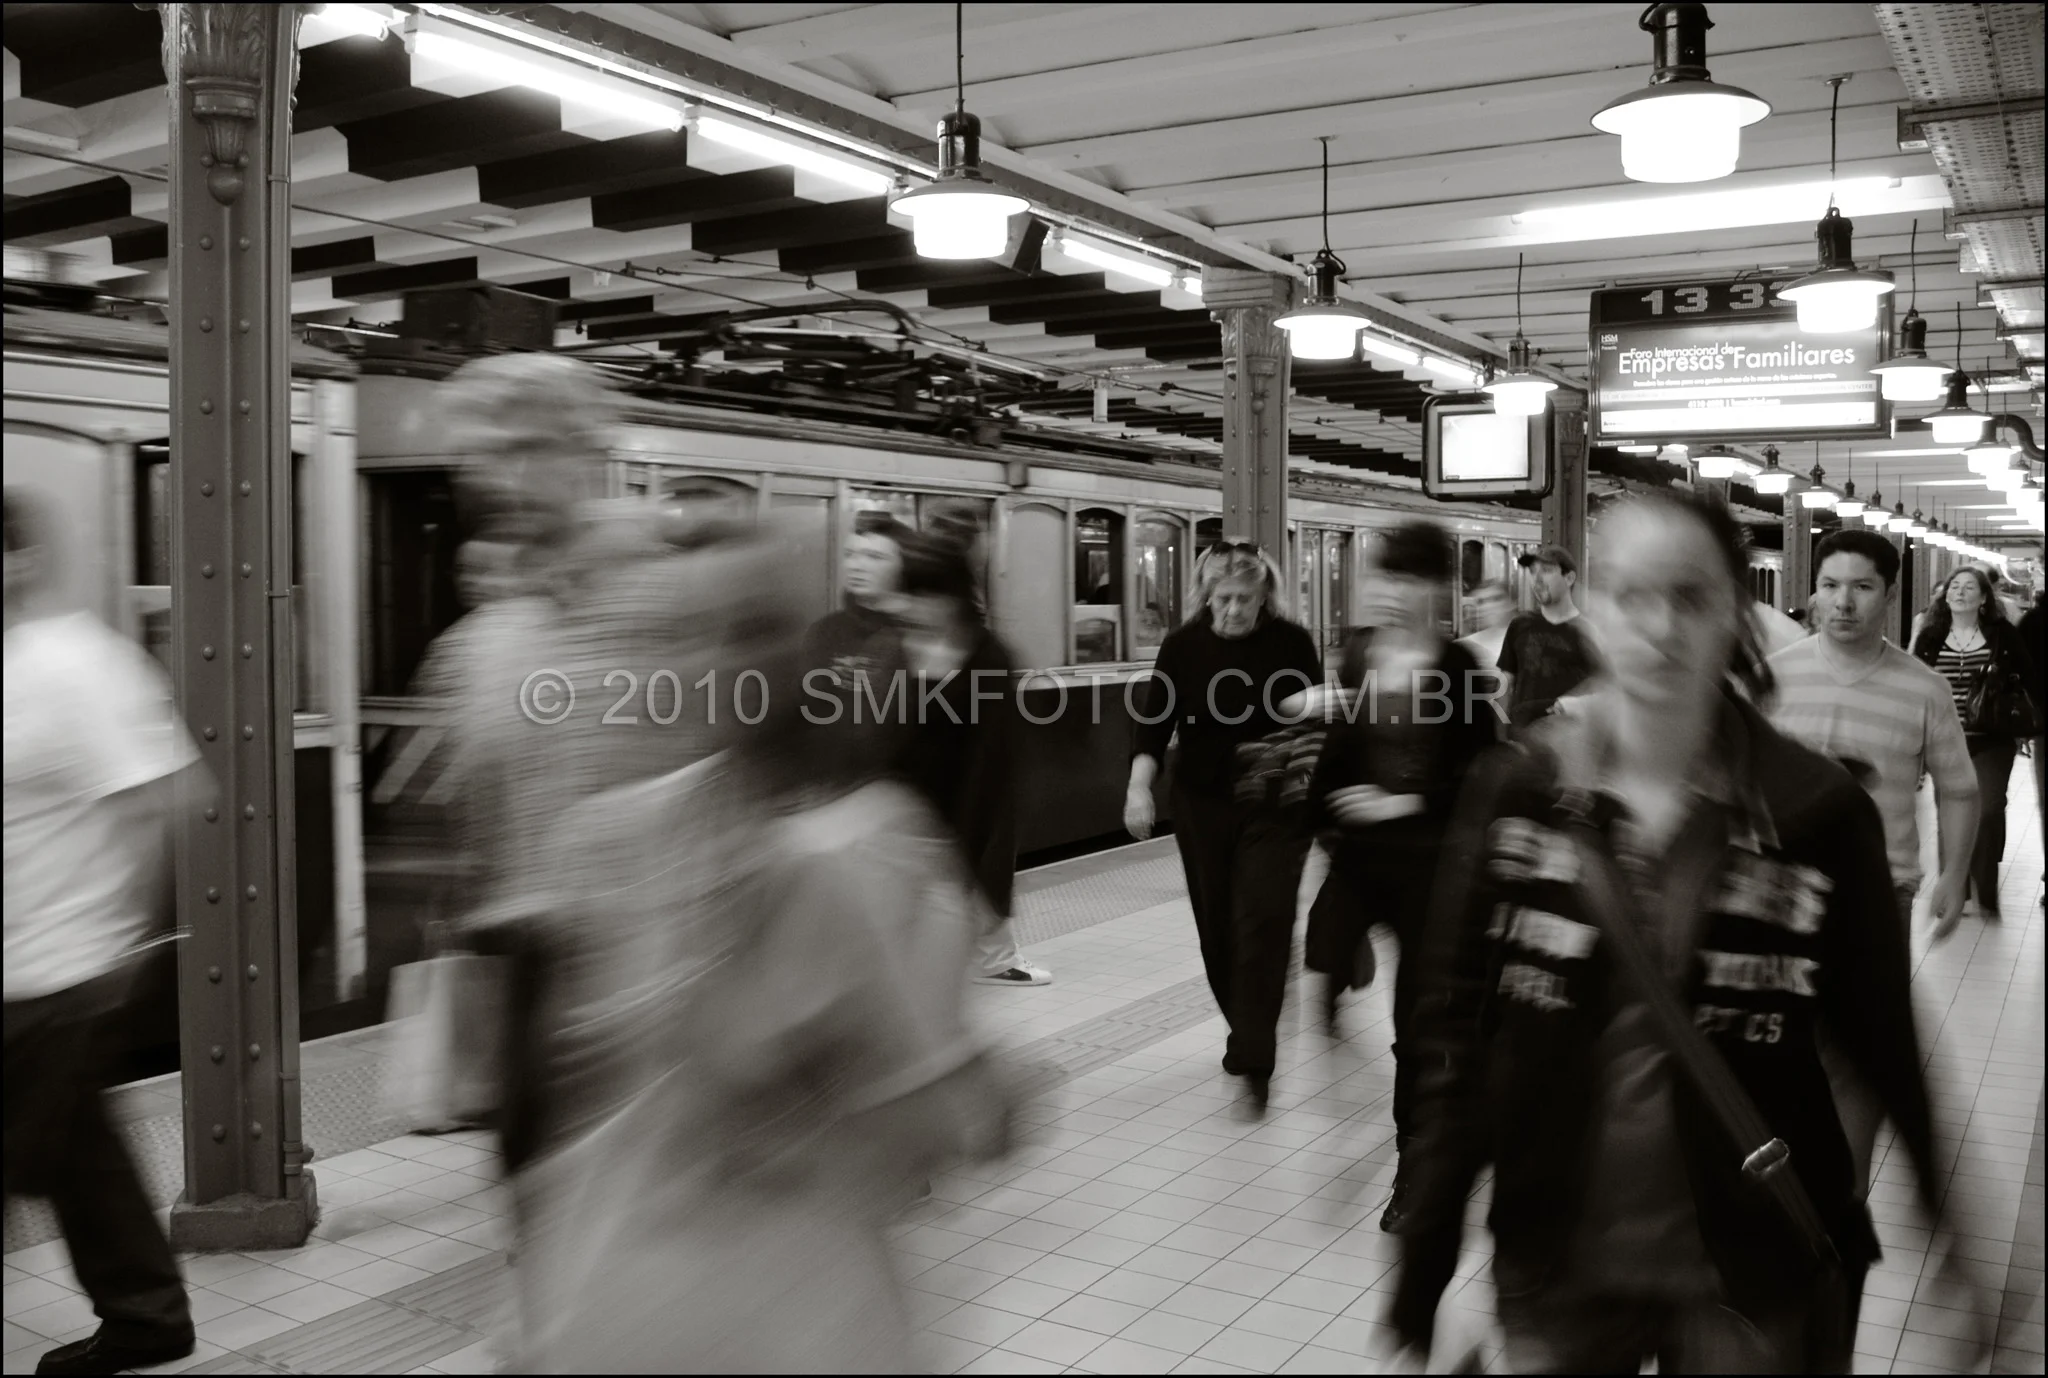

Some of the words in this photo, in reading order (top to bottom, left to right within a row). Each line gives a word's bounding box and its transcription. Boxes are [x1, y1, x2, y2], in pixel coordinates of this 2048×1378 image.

[1641, 287, 1708, 315] 13
[1619, 353, 1725, 380] Empresas
[1733, 341, 1855, 369] Familiares
[1630, 348, 1653, 359] Foro
[1655, 342, 1719, 358] Internacional
[1721, 341, 1735, 355] de
